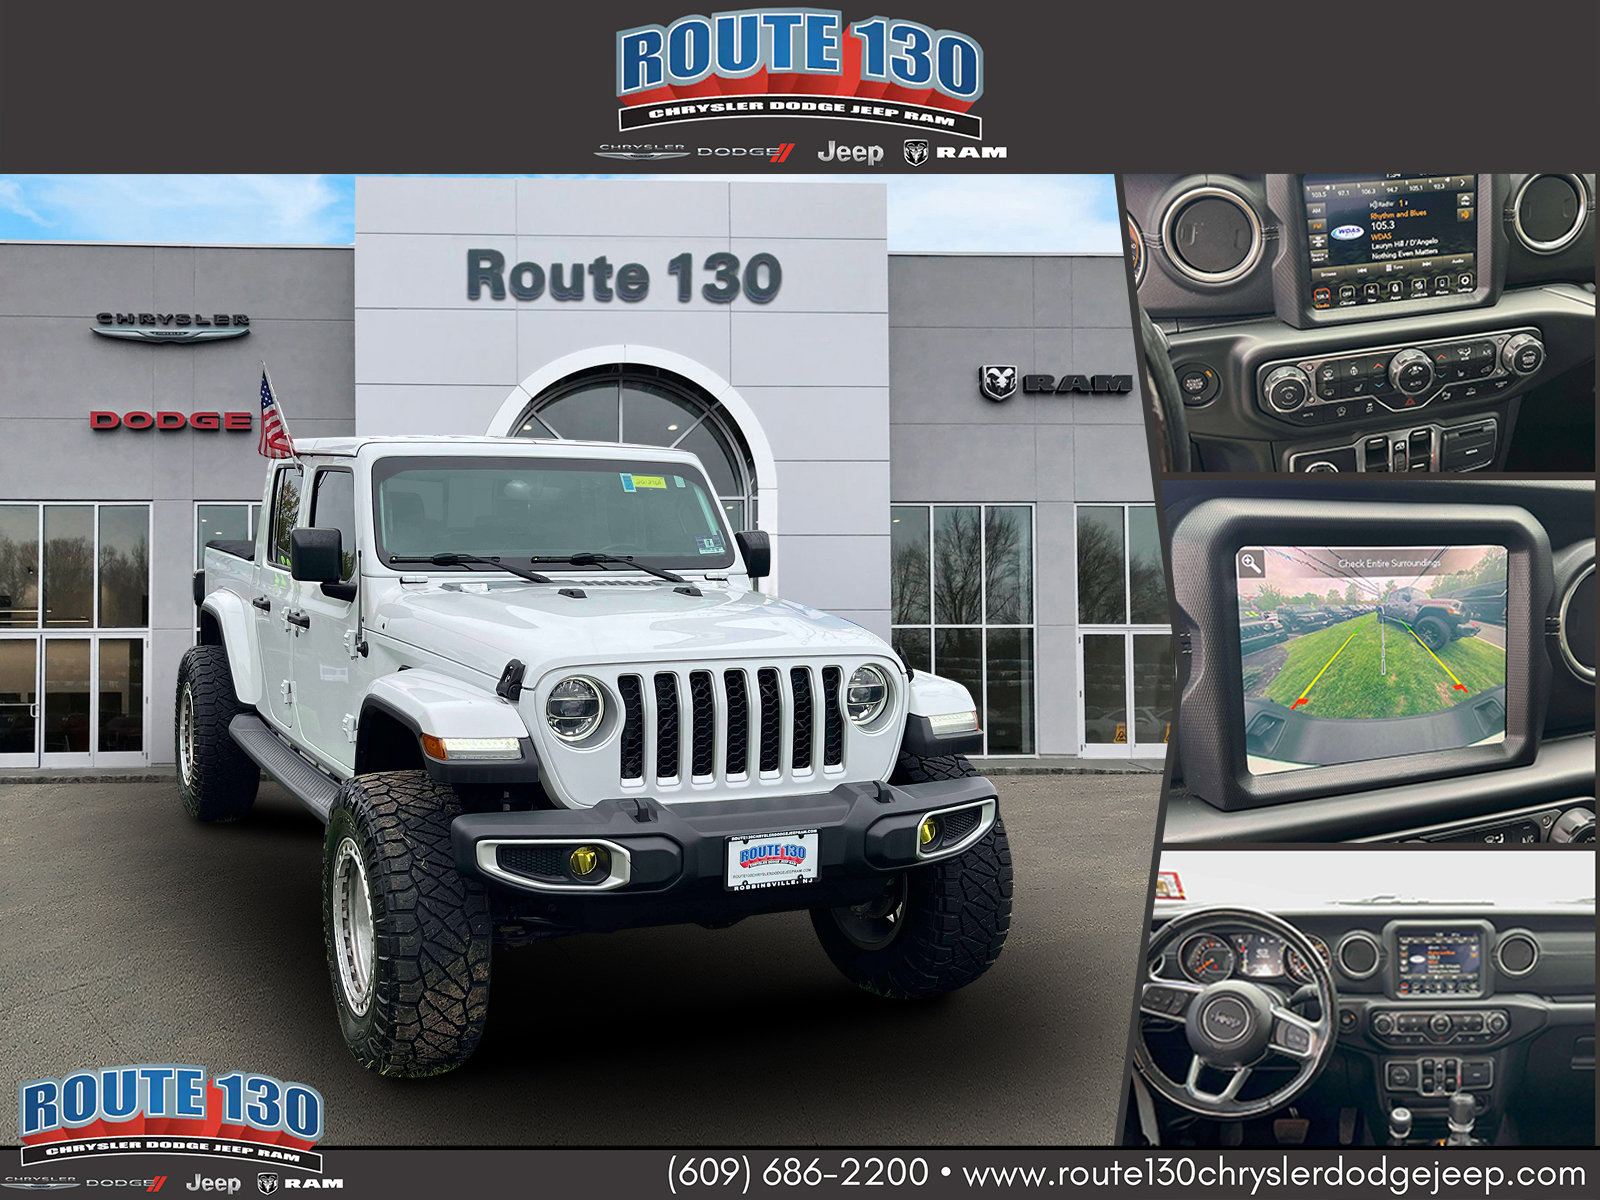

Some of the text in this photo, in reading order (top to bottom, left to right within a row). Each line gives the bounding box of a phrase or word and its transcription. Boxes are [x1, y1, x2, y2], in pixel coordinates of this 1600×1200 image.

[1370, 209, 1428, 220] Rhythm and Blues
[1371, 220, 1396, 231] 105.3
[1370, 232, 1393, 241] WDAS
[1371, 242, 1393, 250] Lauryn
[1410, 237, 1439, 247] D'Angelo
[1371, 248, 1439, 260] Nothing Even Matters
[467, 248, 783, 305] Route 130
[96, 312, 251, 326] CHRYSLER
[1023, 374, 1134, 395] RAM
[89, 410, 253, 431] DODGE
[1338, 557, 1441, 568] Check Entire Surroundings
[740, 844, 806, 862] ROUTE 130
[734, 879, 799, 891] ROBBINSVILLE,
